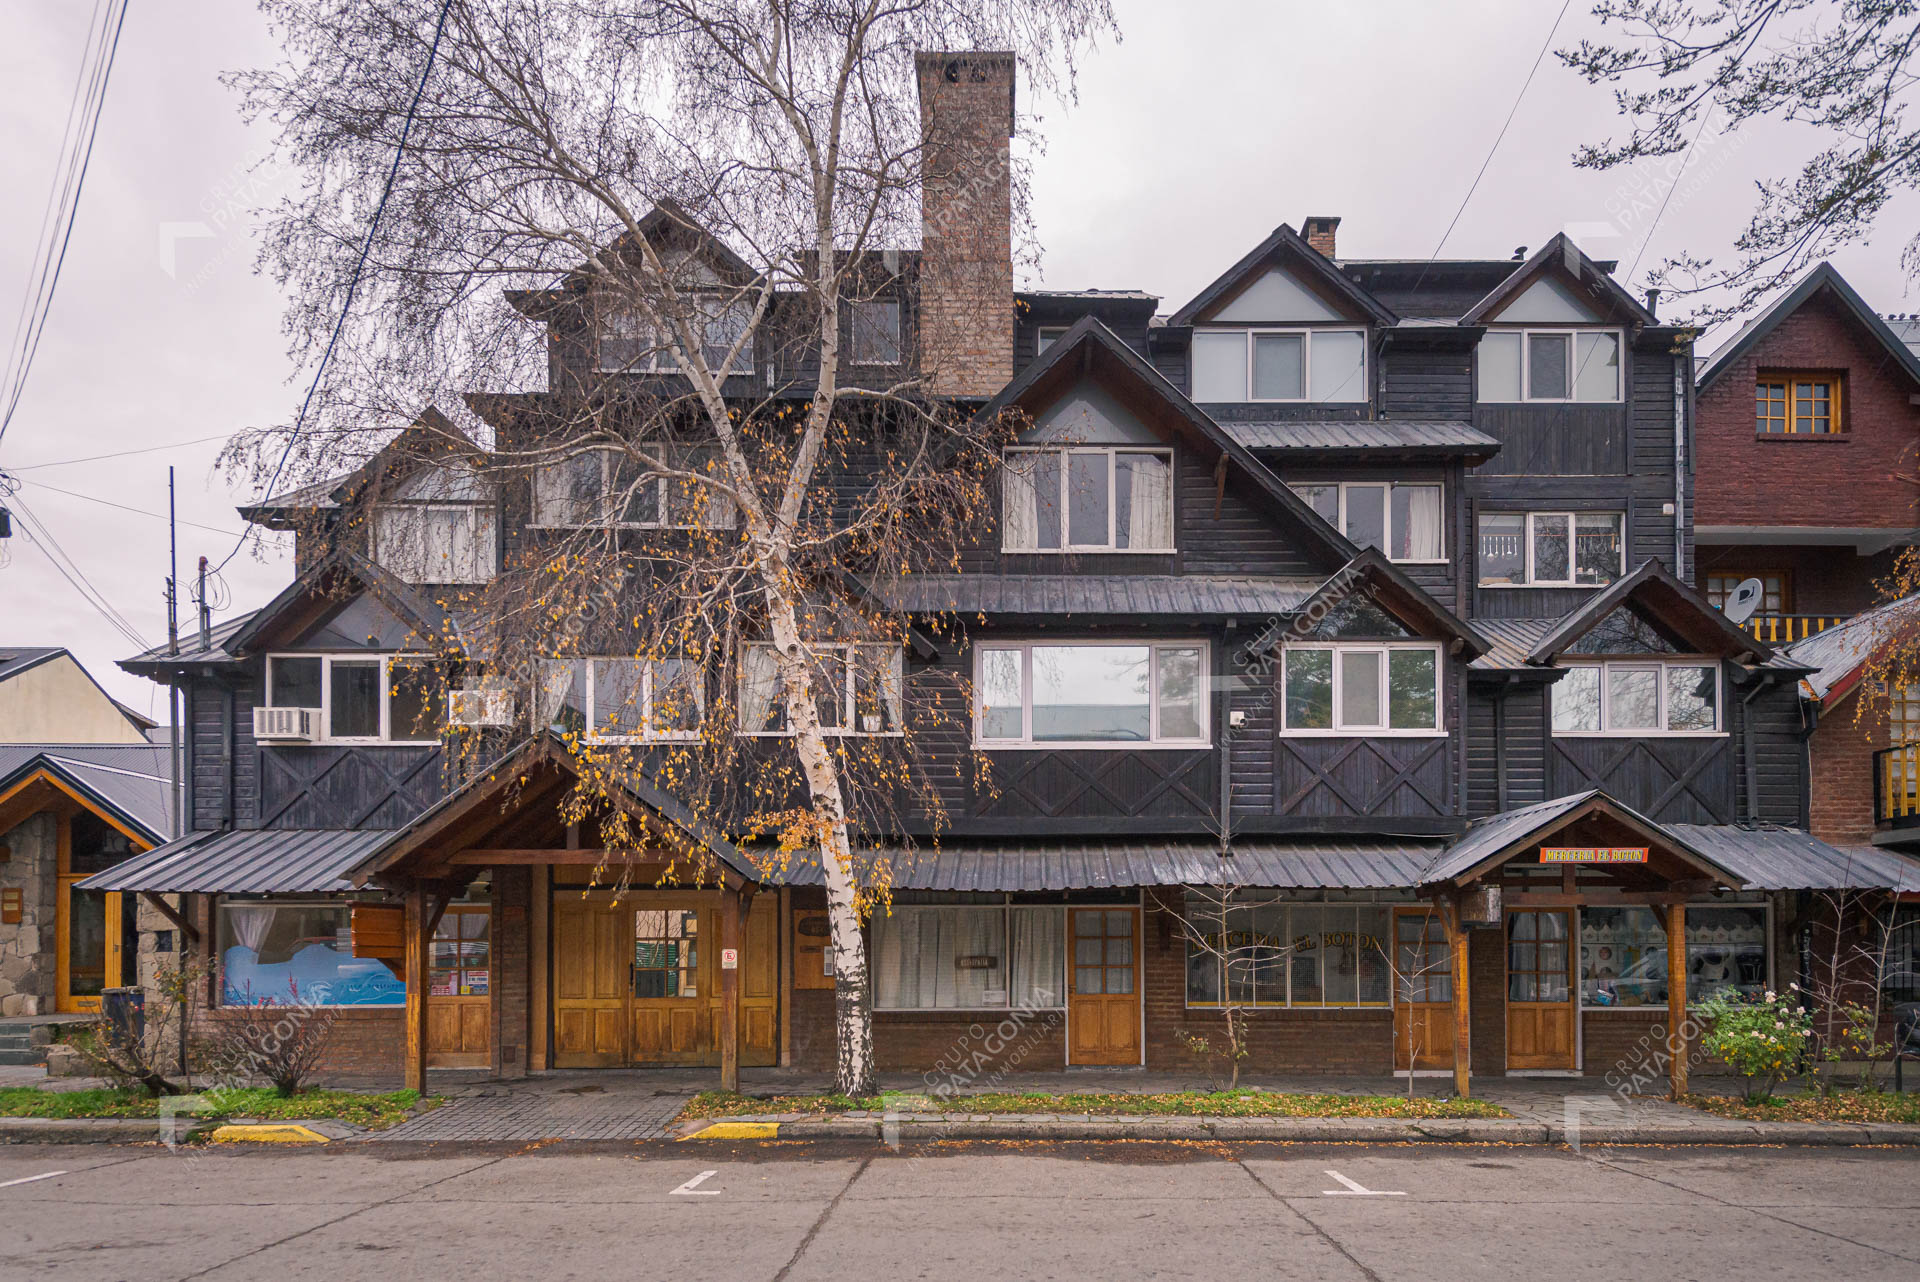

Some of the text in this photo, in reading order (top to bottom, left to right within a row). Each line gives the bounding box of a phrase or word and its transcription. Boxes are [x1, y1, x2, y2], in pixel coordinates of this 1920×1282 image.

[1546, 849, 1595, 861] MERCERIA
[1191, 931, 1385, 953] MECERIA EL BOTON
